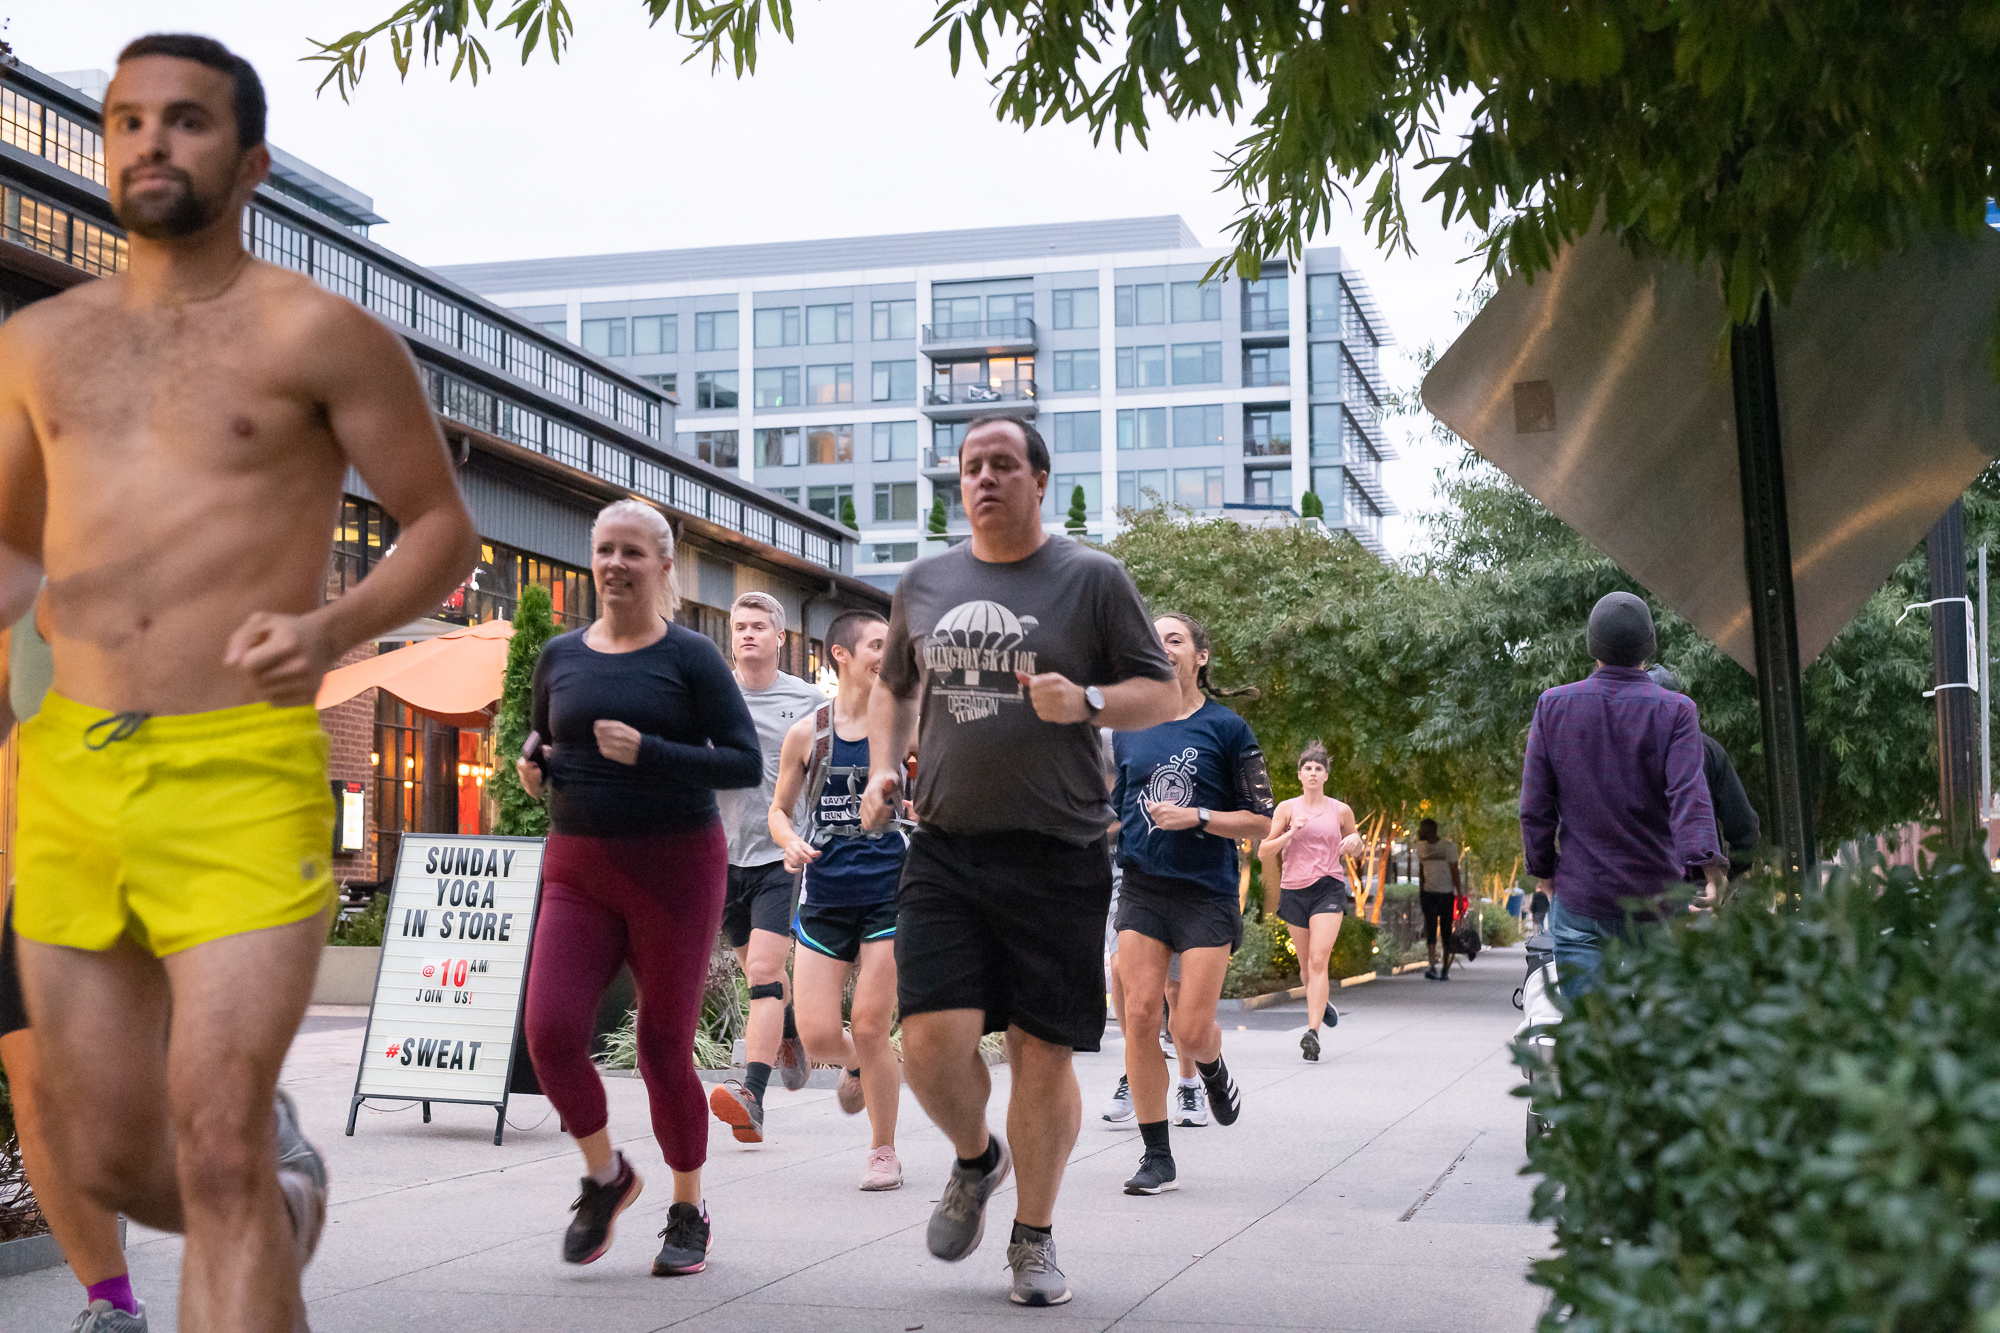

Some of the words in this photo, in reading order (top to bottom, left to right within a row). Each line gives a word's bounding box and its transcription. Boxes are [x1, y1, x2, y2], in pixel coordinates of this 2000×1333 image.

[822, 796, 846, 805] NAVY
[824, 812, 842, 820] RUN
[426, 847, 516, 877] SUNDAY
[437, 879, 495, 909] YOGA
[403, 909, 427, 937] IN
[440, 911, 512, 941] STORE
[415, 988, 443, 1003] JOIN
[454, 990, 473, 1004] US!
[385, 1037, 482, 1070] #SWEAT
